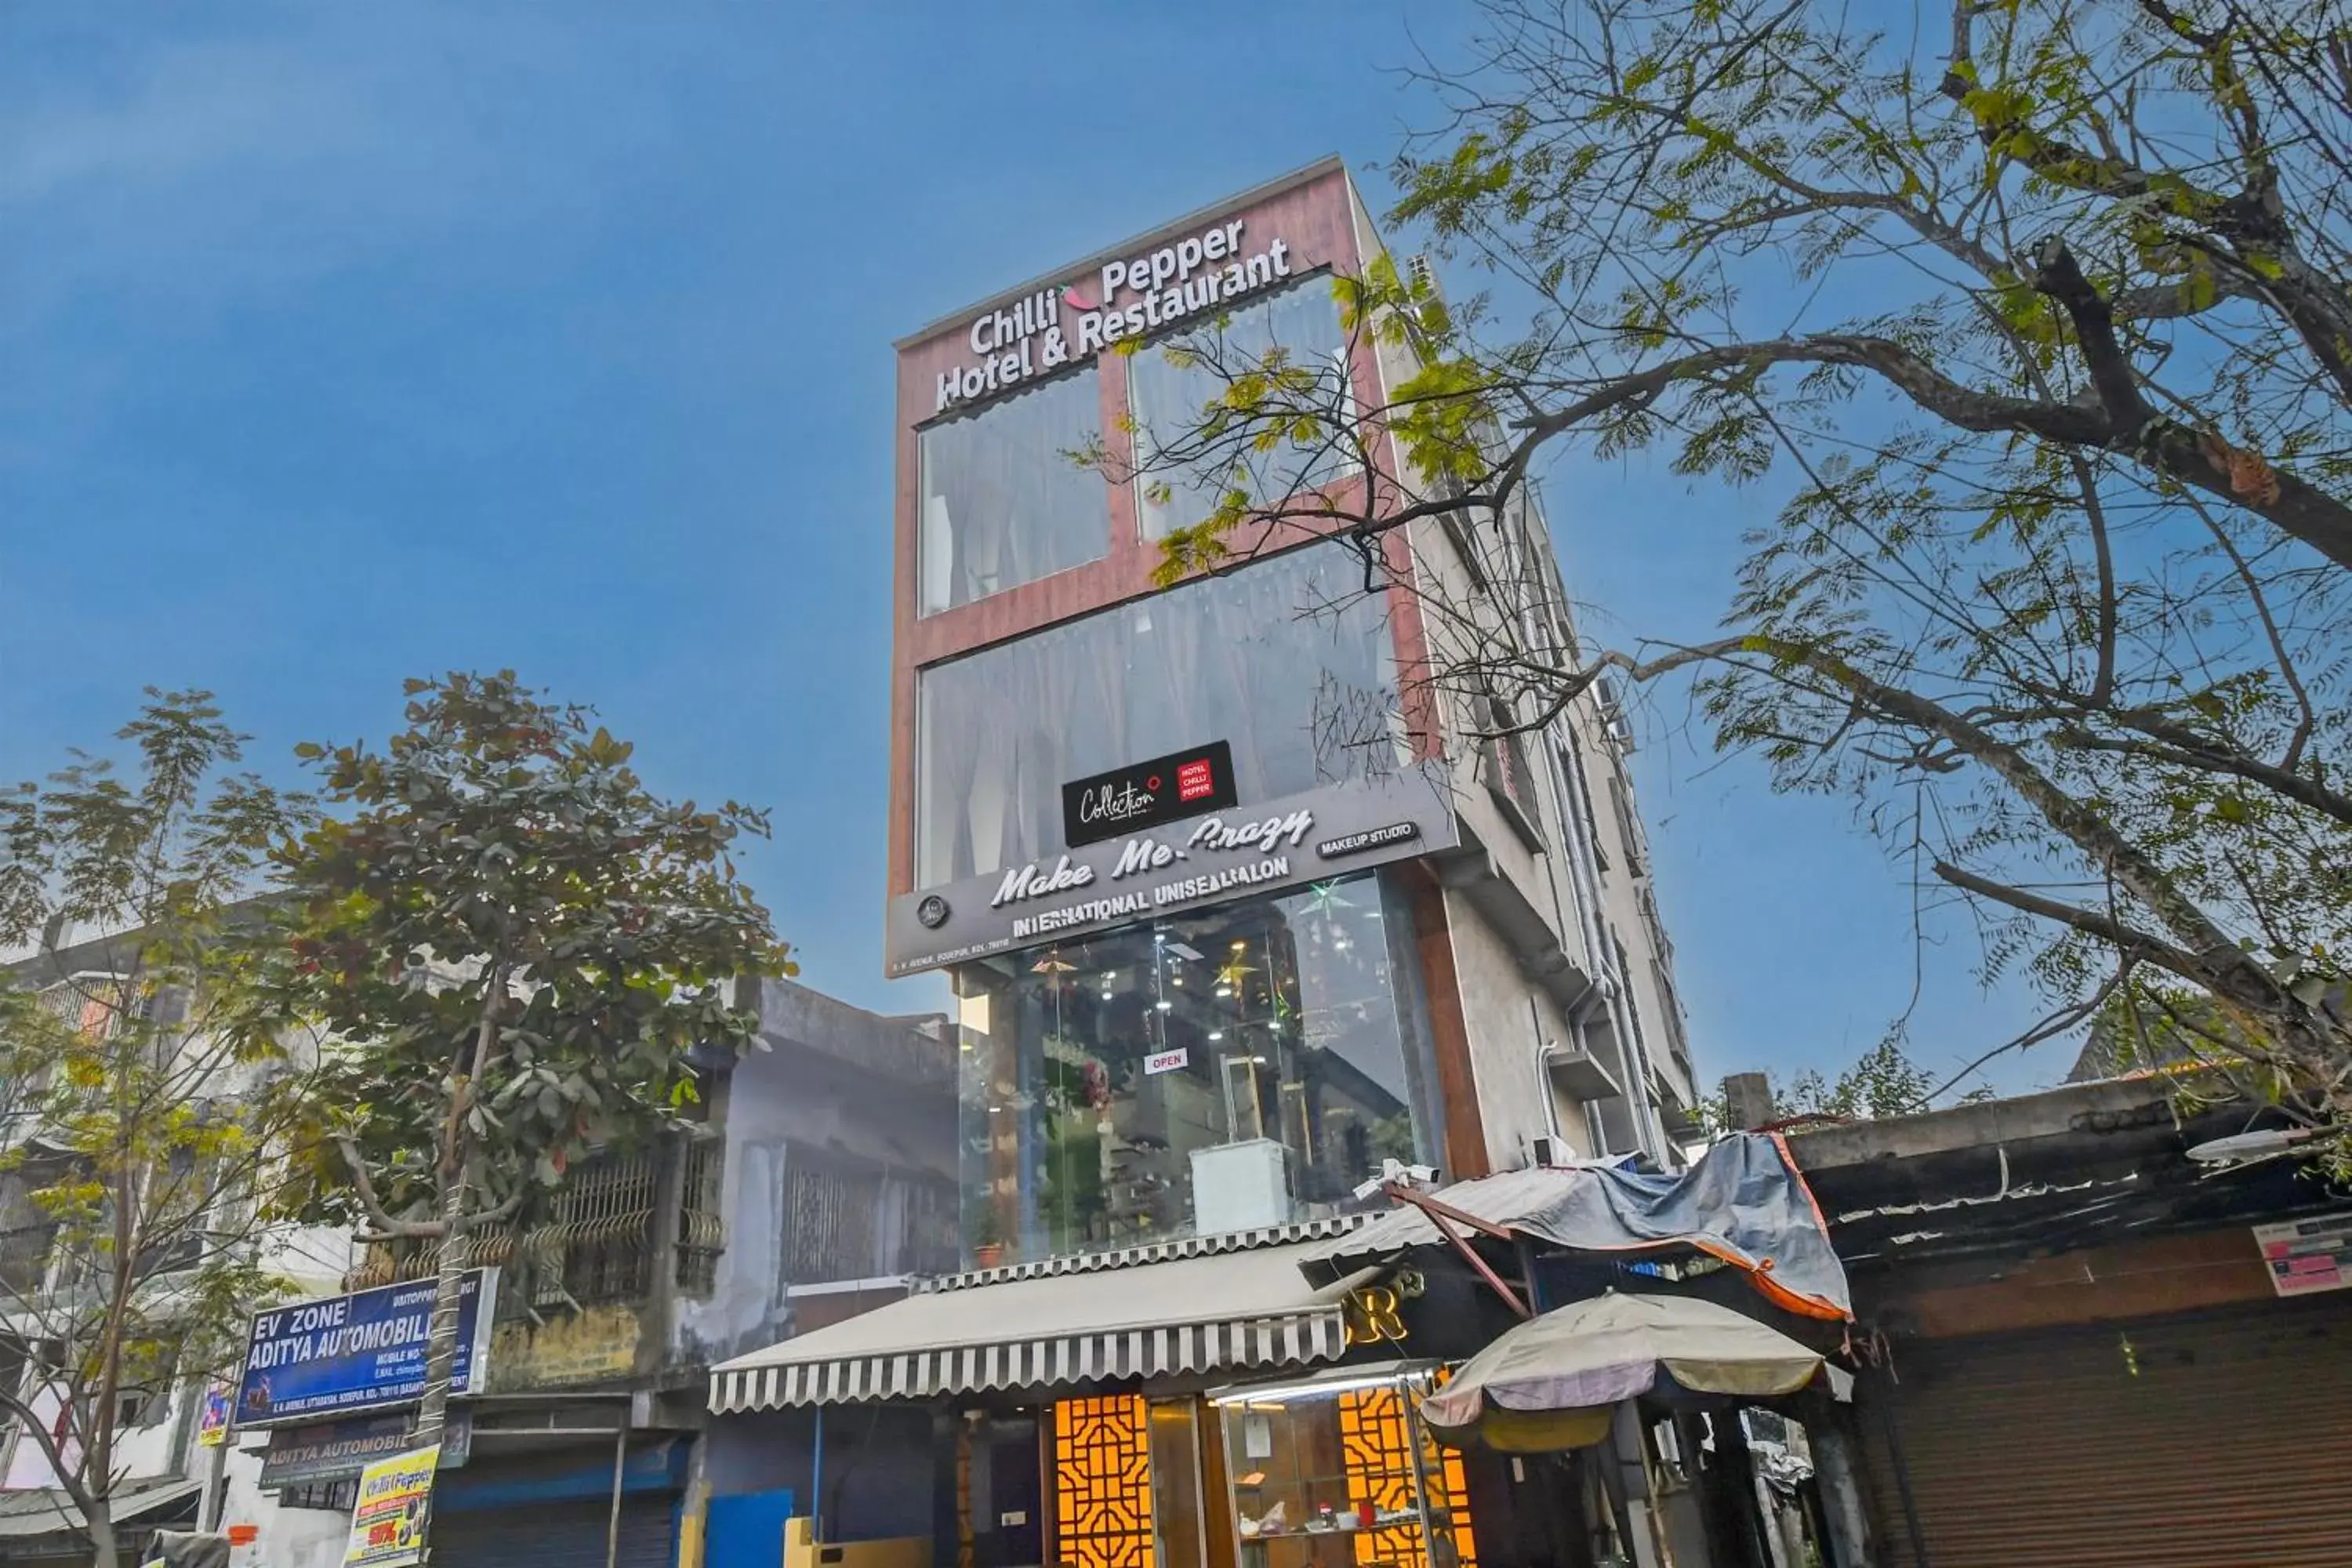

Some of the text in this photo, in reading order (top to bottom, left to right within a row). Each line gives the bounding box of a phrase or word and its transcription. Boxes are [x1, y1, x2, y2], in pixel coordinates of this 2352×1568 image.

[970, 219, 1244, 356] Chilli Pepper
[937, 238, 1290, 413] Hotel & Restaurant
[1080, 781, 1155, 823] Collection
[1181, 784, 1210, 797] PEPPER
[1321, 823, 1412, 854] MAKEUP STUDIO
[990, 855, 1094, 908] Make
[1153, 1054, 1181, 1069] OPEN
[255, 1301, 347, 1340] EV ZONE
[248, 1335, 312, 1370] ADITYA
[267, 1445, 318, 1466] ADITYA
[321, 1435, 409, 1458] AUTOMOBIL
